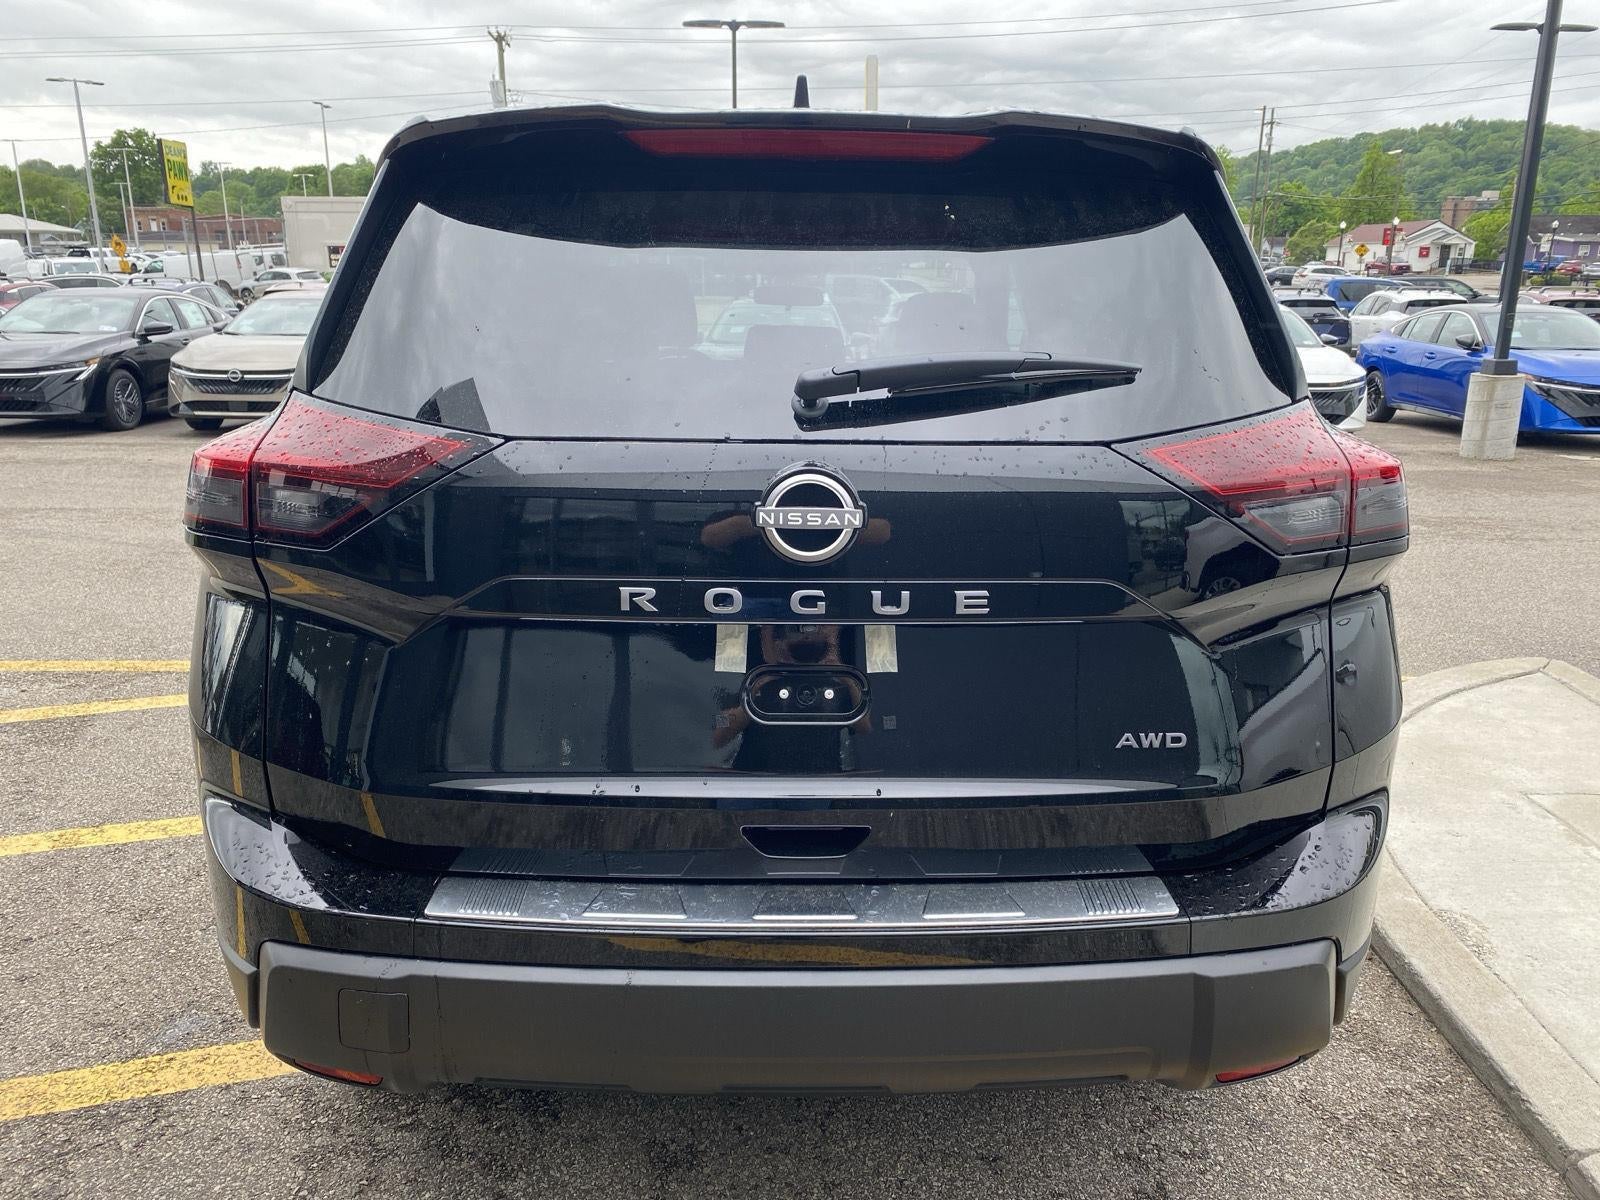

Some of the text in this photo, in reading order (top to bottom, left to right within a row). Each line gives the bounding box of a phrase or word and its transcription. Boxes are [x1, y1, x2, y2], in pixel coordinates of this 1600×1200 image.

[167, 158, 188, 181] PAWN
[759, 512, 860, 526] NISSAN
[619, 586, 991, 615] ROGUE
[1115, 732, 1188, 749] AWD
